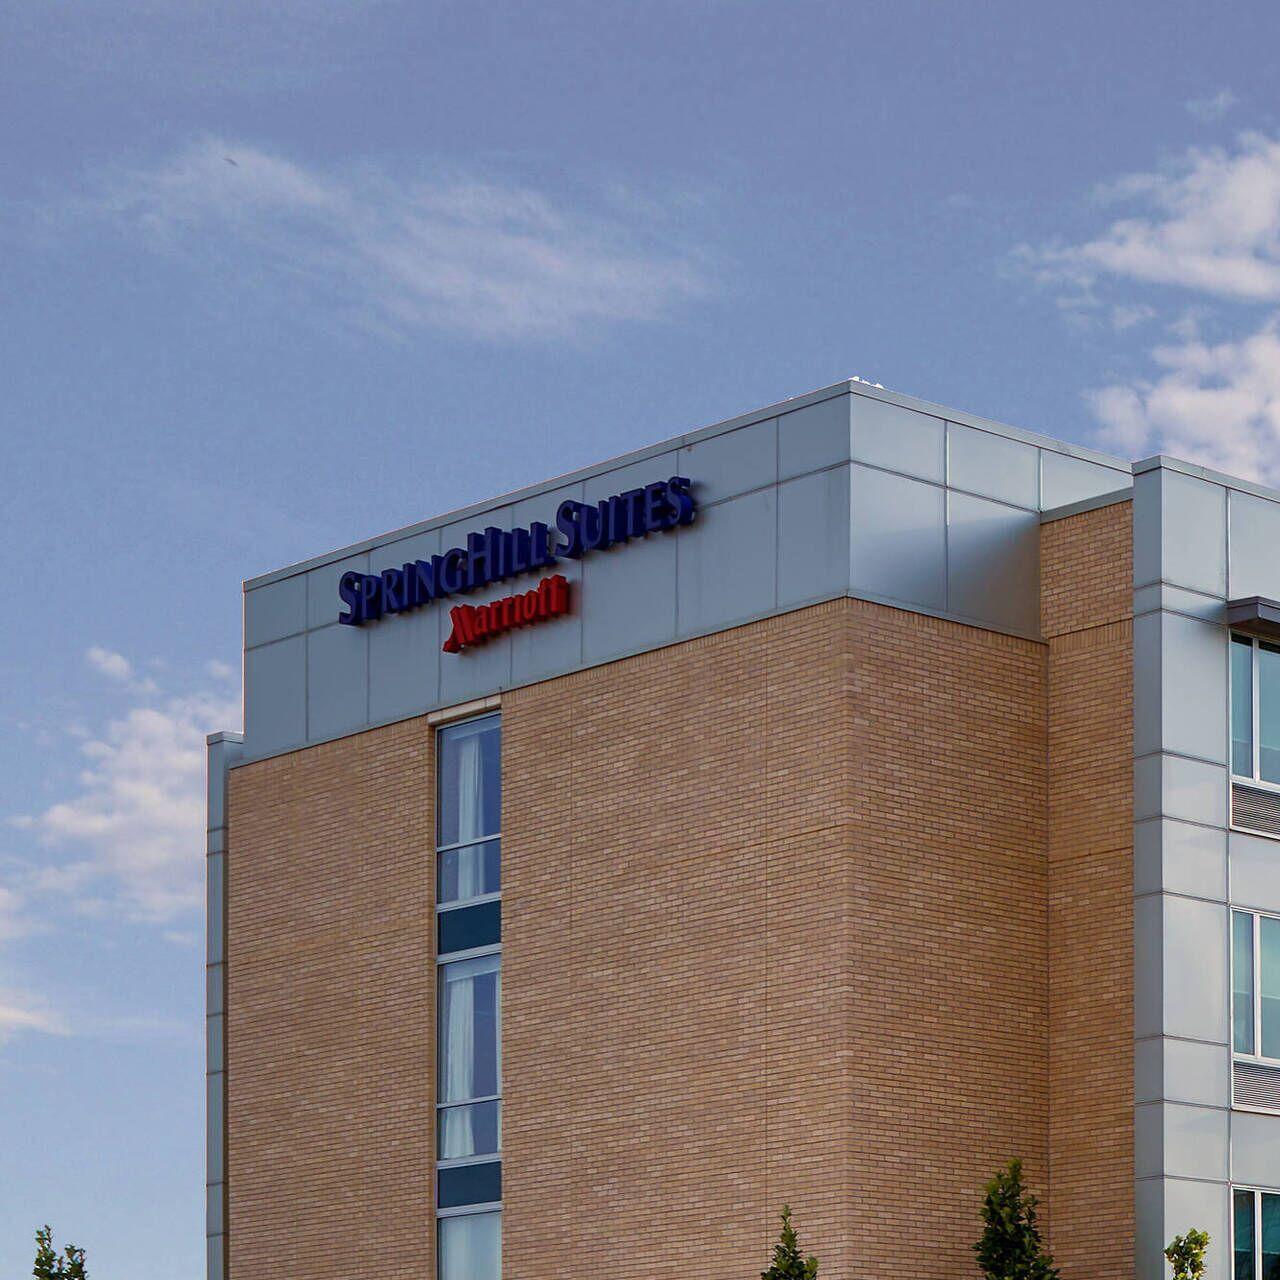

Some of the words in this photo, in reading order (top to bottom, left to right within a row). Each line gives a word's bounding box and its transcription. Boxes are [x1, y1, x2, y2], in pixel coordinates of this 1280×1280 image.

[338, 521, 558, 626] SPRINGHILL
[555, 476, 697, 559] SUITES
[442, 574, 571, 654] Marriott
